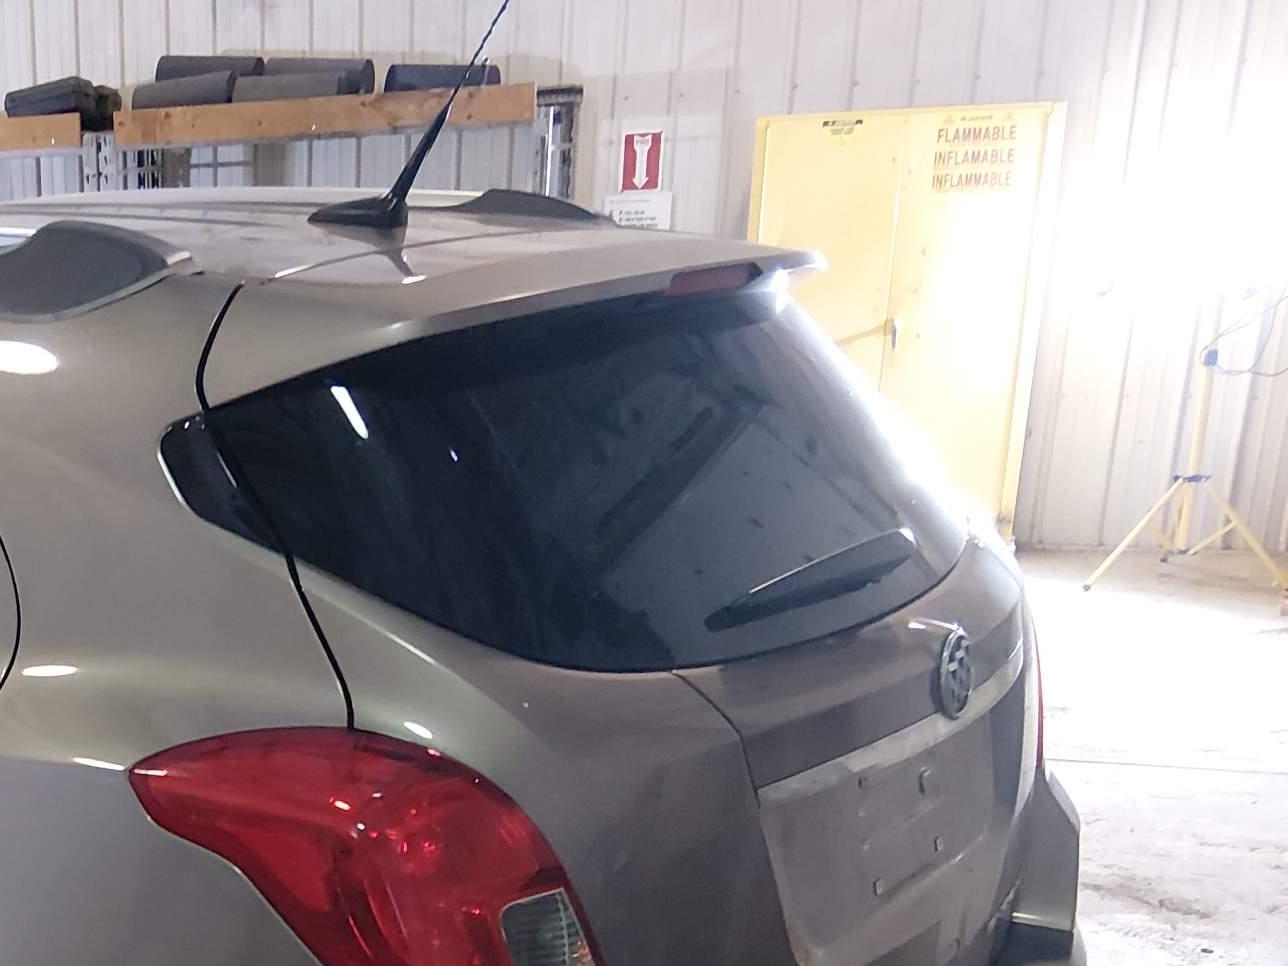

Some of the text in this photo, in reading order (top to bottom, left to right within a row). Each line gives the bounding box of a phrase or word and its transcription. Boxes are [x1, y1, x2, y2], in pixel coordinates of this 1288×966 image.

[937, 124, 1016, 144] FLAMMABLE
[934, 148, 1016, 166] INFLAMABLE
[931, 171, 1013, 190] INFLAMMABLE
